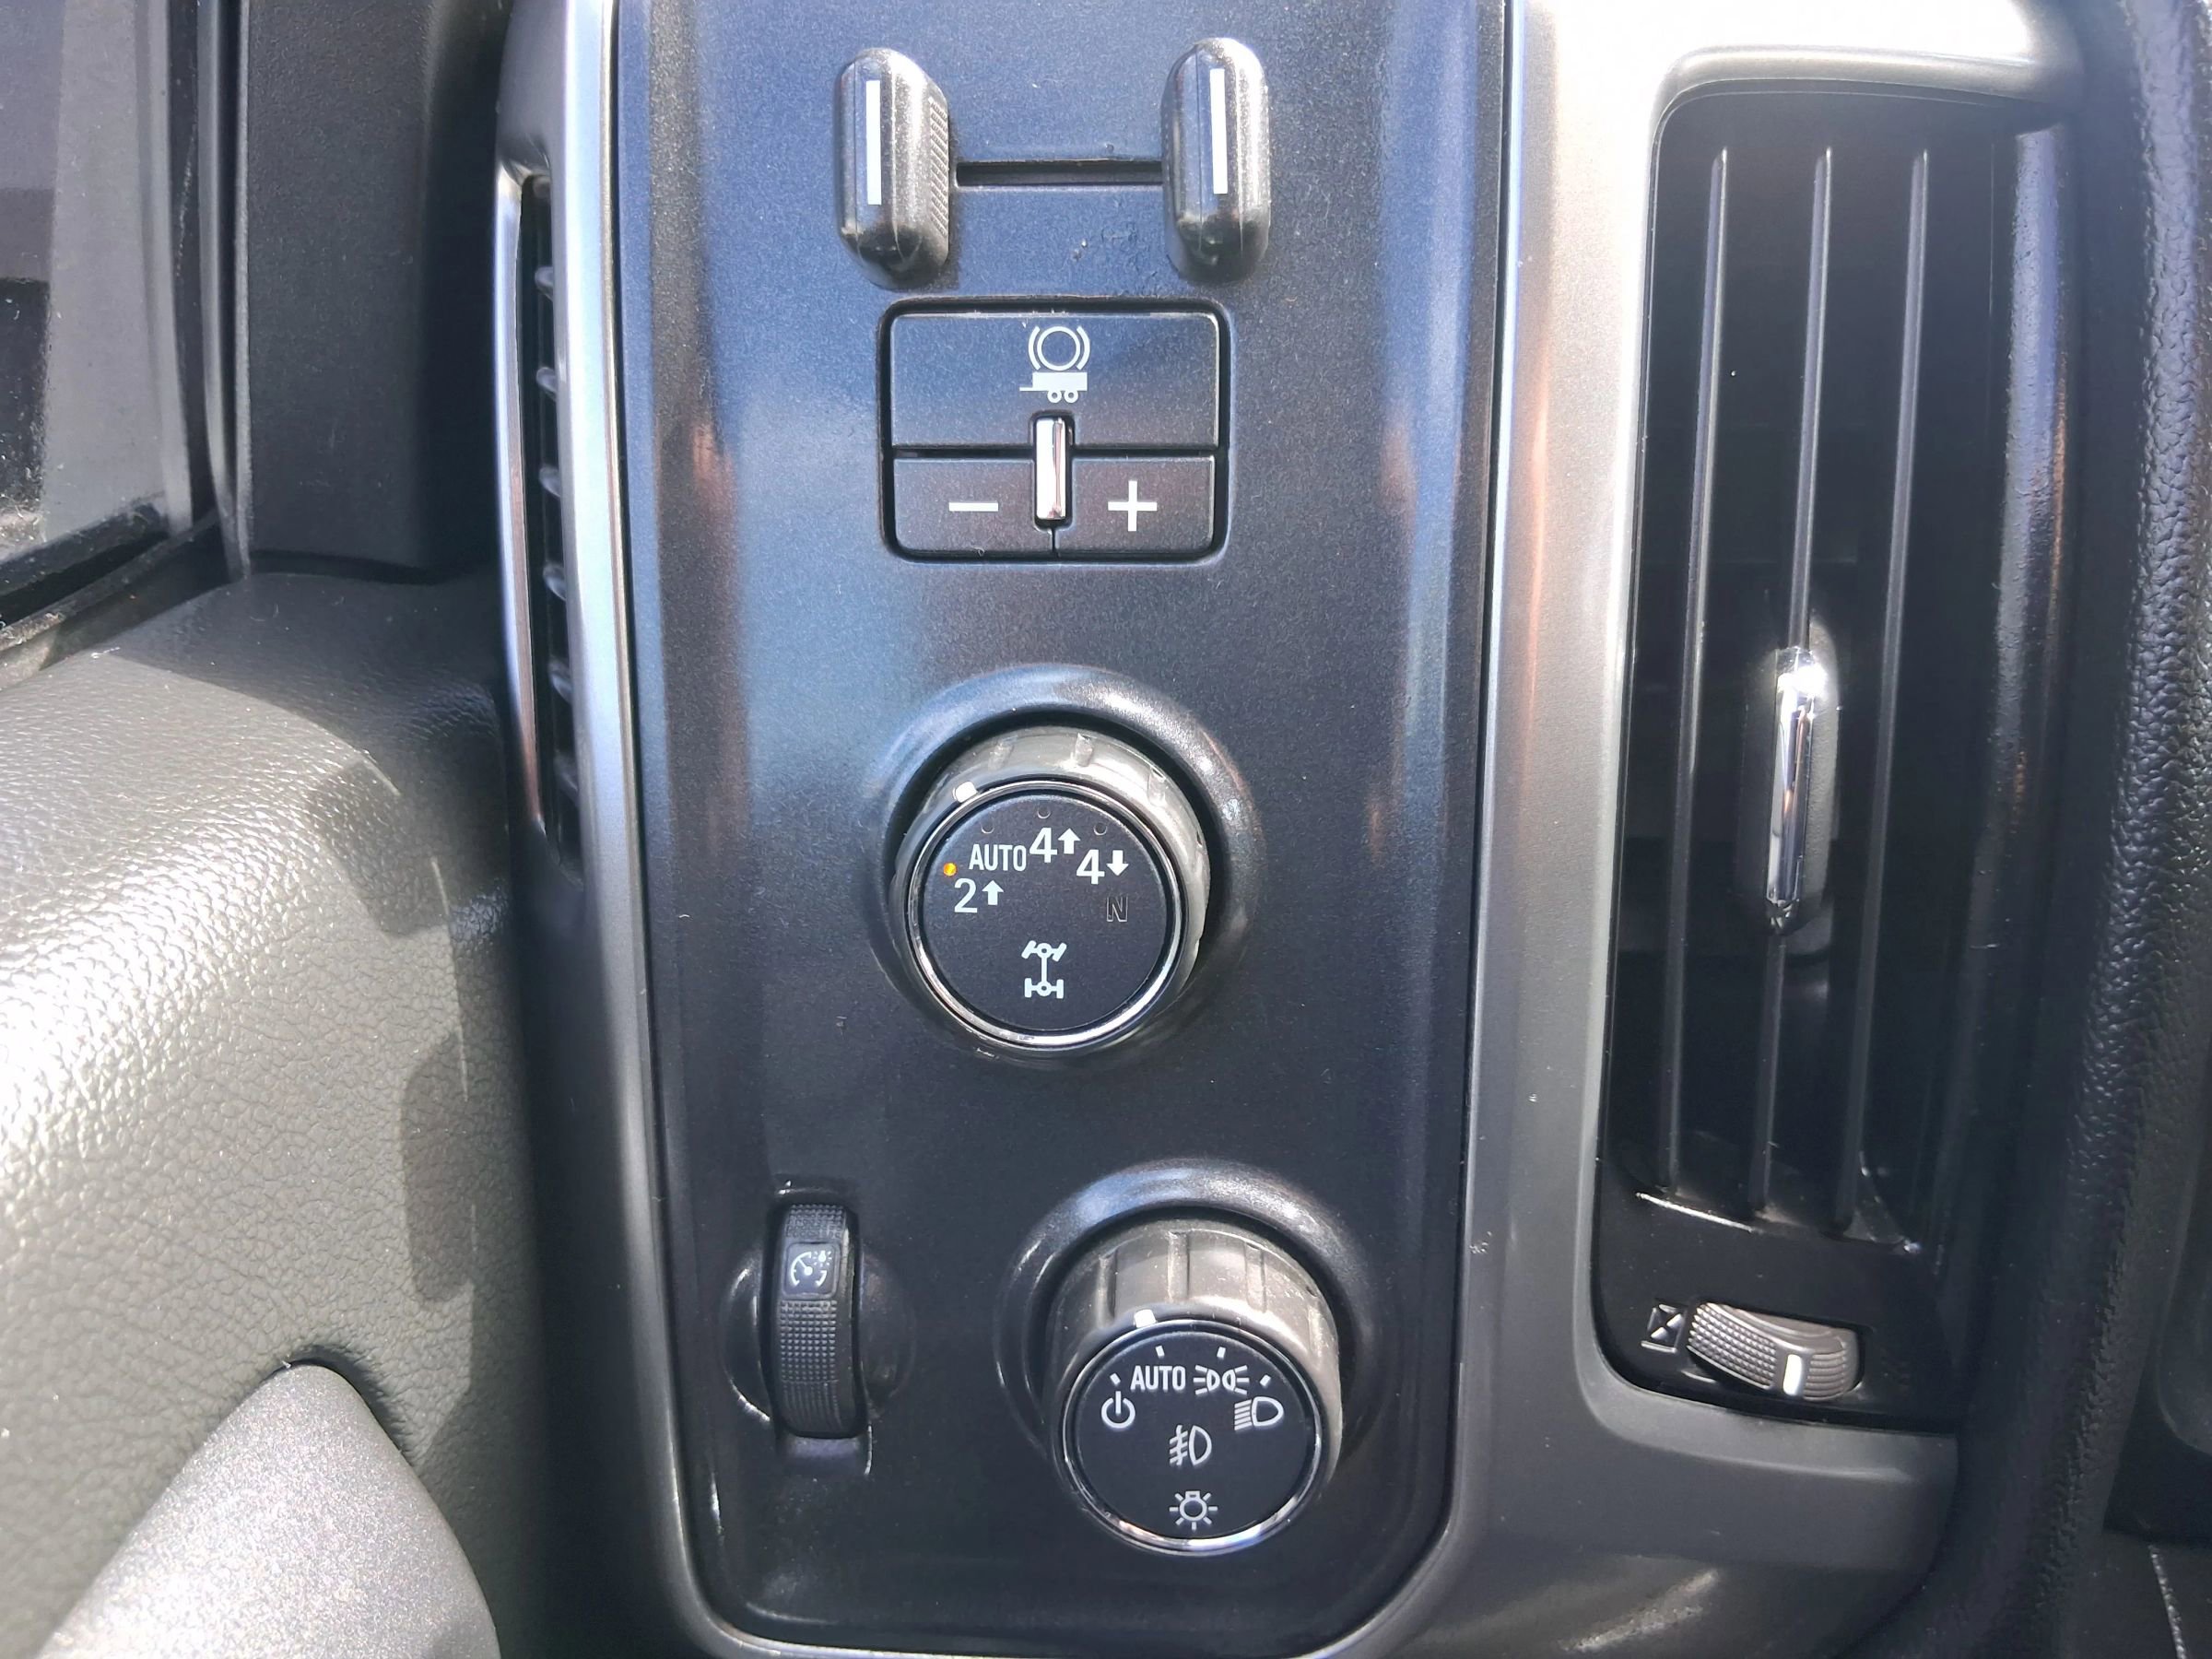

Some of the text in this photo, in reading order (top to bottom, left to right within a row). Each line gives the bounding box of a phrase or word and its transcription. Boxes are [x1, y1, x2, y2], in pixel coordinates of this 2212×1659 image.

[968, 842, 1027, 872] AUTO
[1029, 827, 1058, 864] 4
[1076, 849, 1105, 885] 4
[954, 877, 978, 913] 2
[1106, 896, 1128, 923] N
[1130, 1365, 1186, 1393] AUTO
